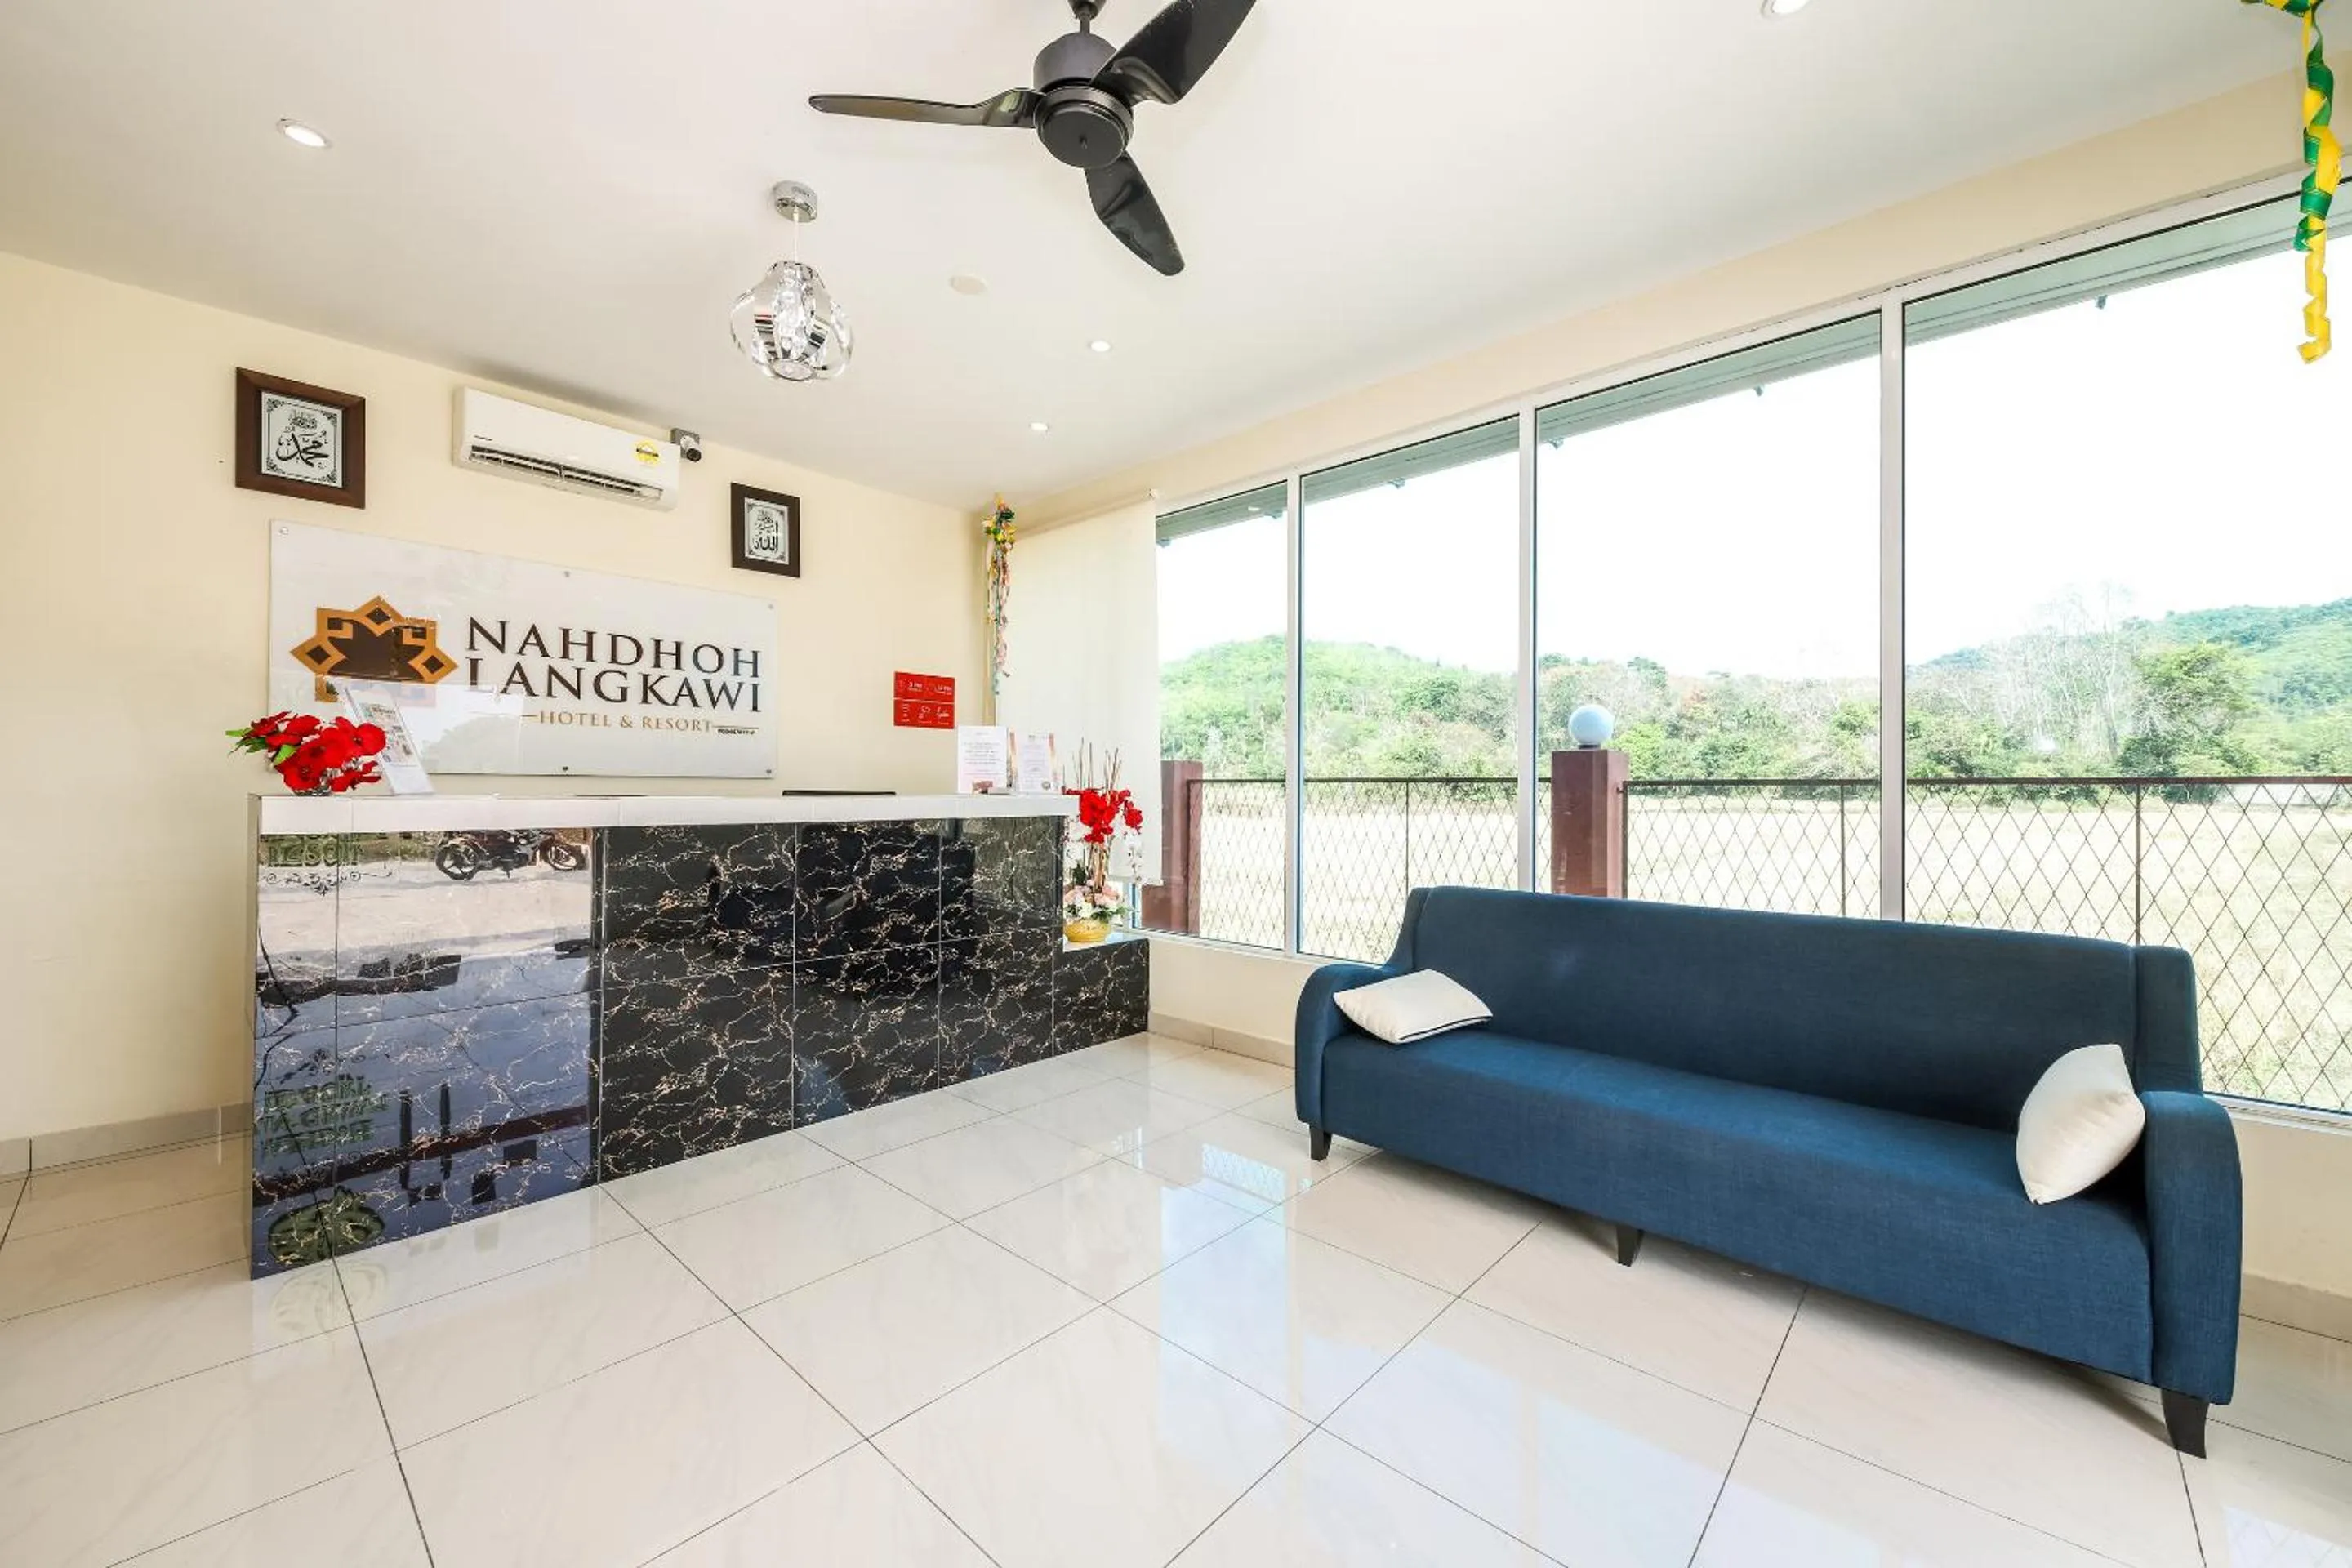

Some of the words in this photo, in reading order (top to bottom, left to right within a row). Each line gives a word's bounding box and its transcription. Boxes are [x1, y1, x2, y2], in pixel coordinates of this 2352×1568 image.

[466, 617, 762, 678] NAHDHOH
[466, 656, 762, 713] LANGKAWI
[540, 710, 612, 728] HOTEL
[620, 715, 634, 729] &
[641, 715, 711, 733] RESORT
